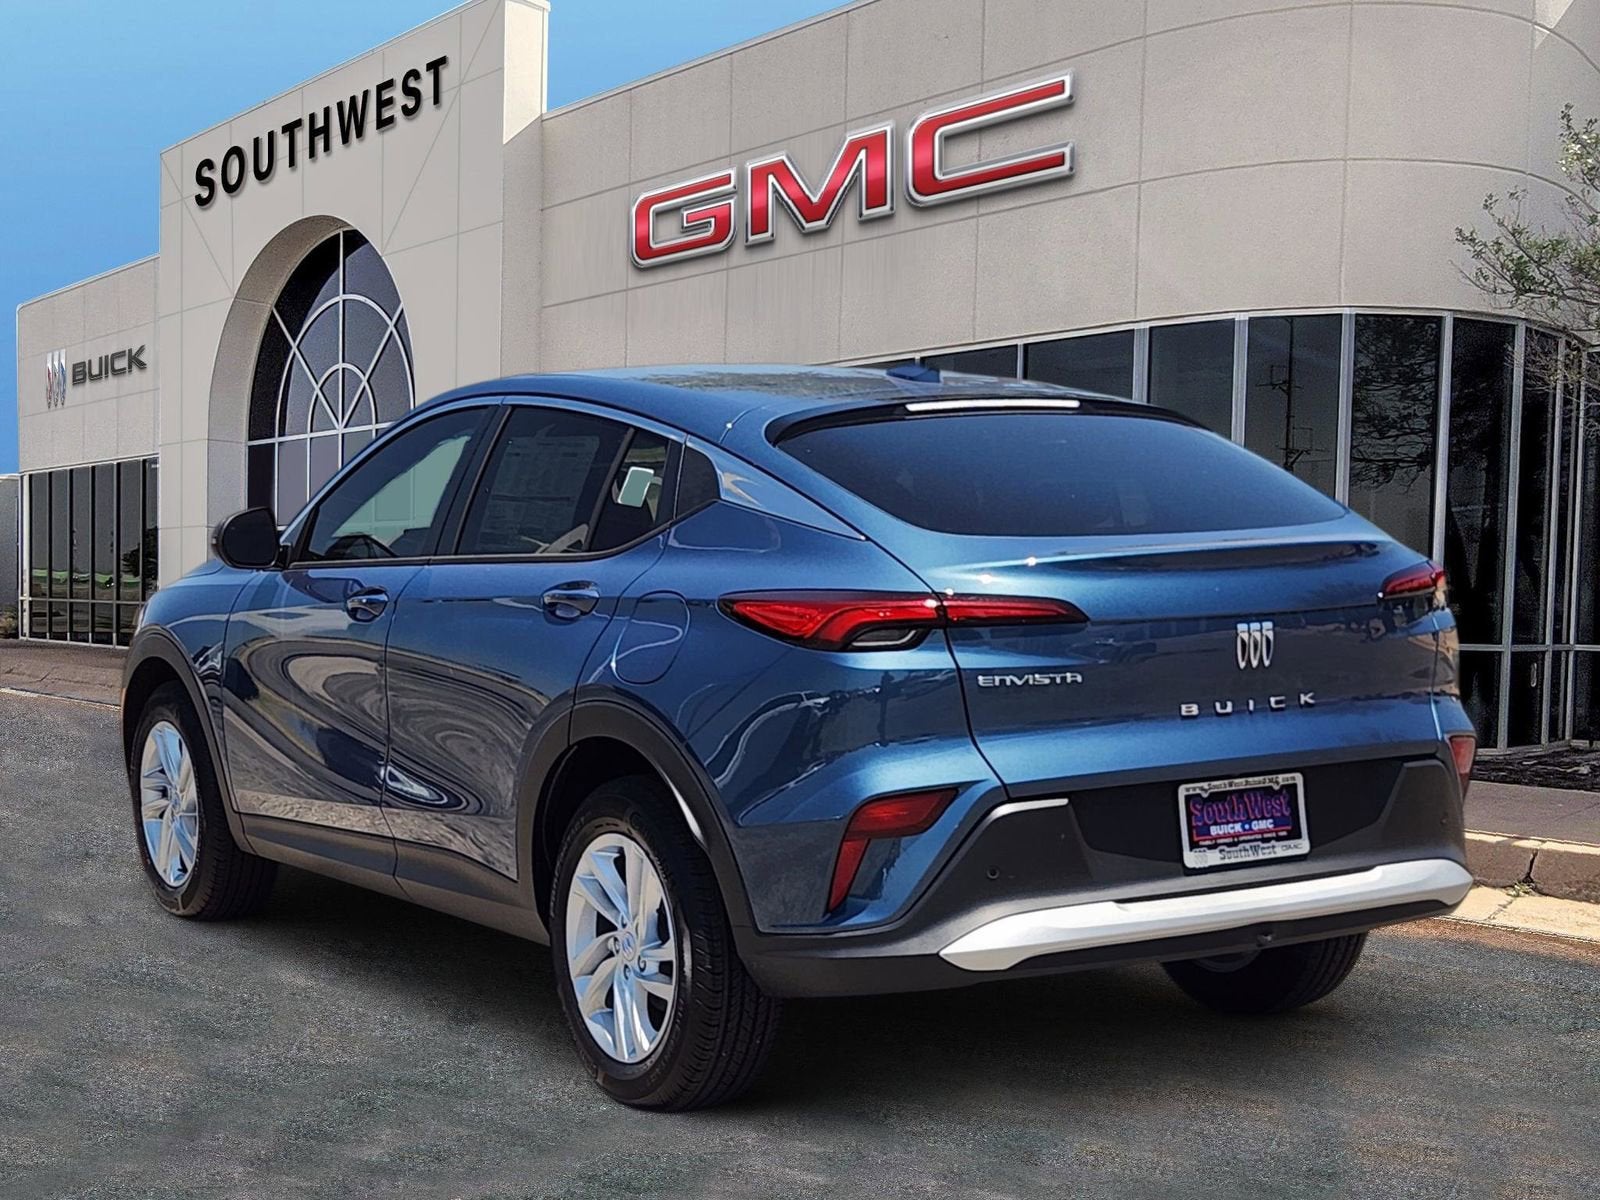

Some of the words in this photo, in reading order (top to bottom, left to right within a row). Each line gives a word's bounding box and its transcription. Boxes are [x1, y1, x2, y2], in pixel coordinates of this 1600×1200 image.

[194, 55, 447, 207] SOUTHWEST
[630, 69, 1075, 268] GMC
[72, 344, 147, 385] BUICK
[977, 672, 1083, 688] ENVISTA
[1180, 691, 1316, 718] BUICK
[1209, 822, 1243, 836] BUICK
[1251, 819, 1275, 832] GMC
